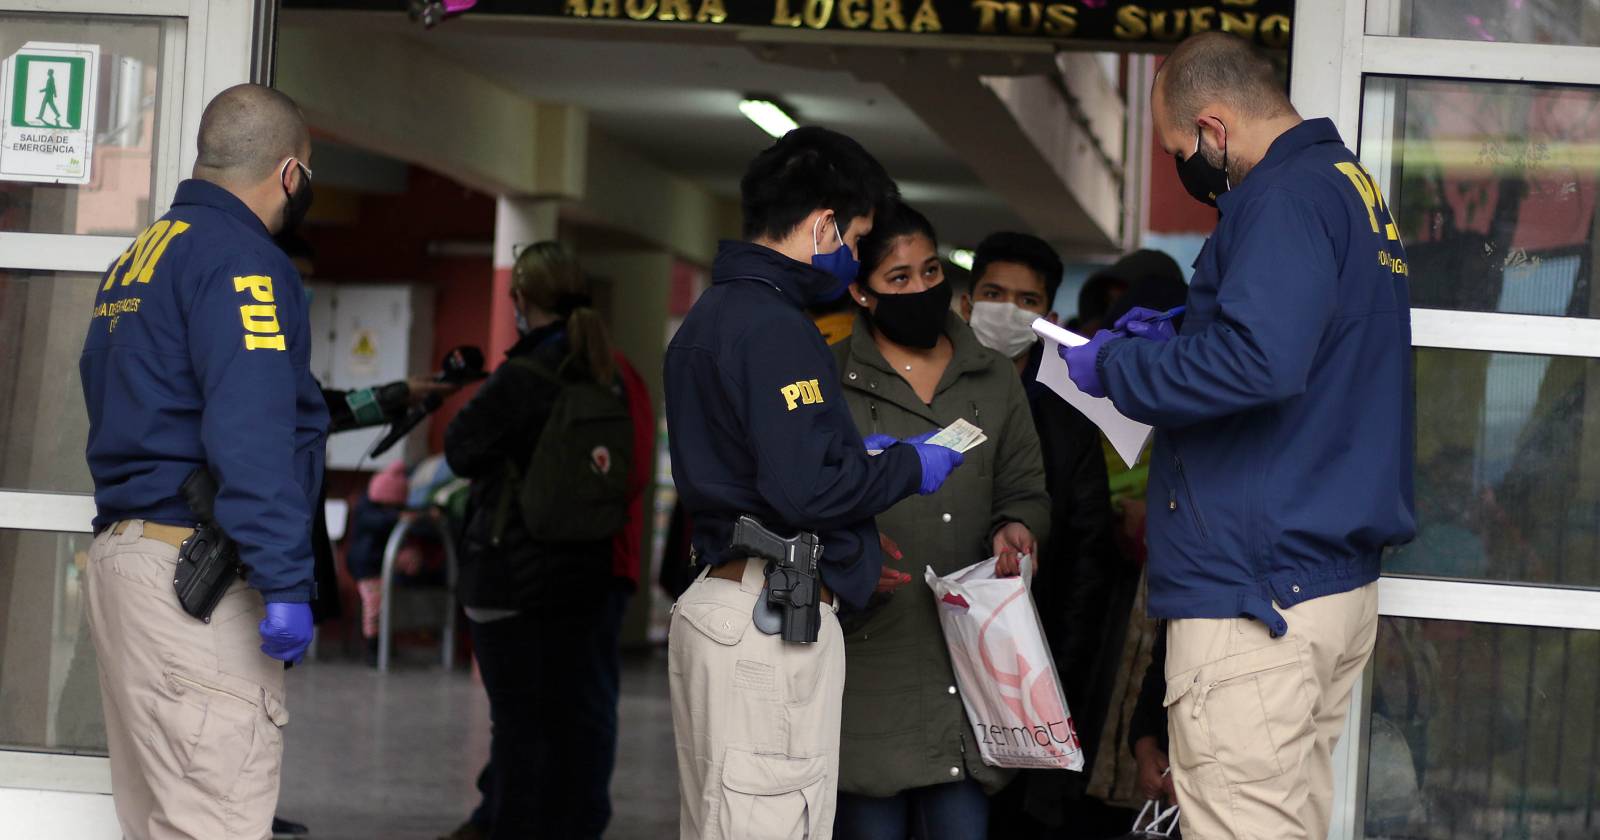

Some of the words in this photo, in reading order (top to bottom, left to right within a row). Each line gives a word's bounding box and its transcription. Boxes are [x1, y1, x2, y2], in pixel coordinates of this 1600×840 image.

[771, 0, 942, 32] LOGRA
[971, 0, 1078, 34] TUS
[12, 142, 75, 154] EMERGENCIA
[20, 133, 54, 144] SALIDA
[56, 135, 69, 145] DE
[233, 275, 286, 351] PDI
[780, 378, 824, 411] PDI
